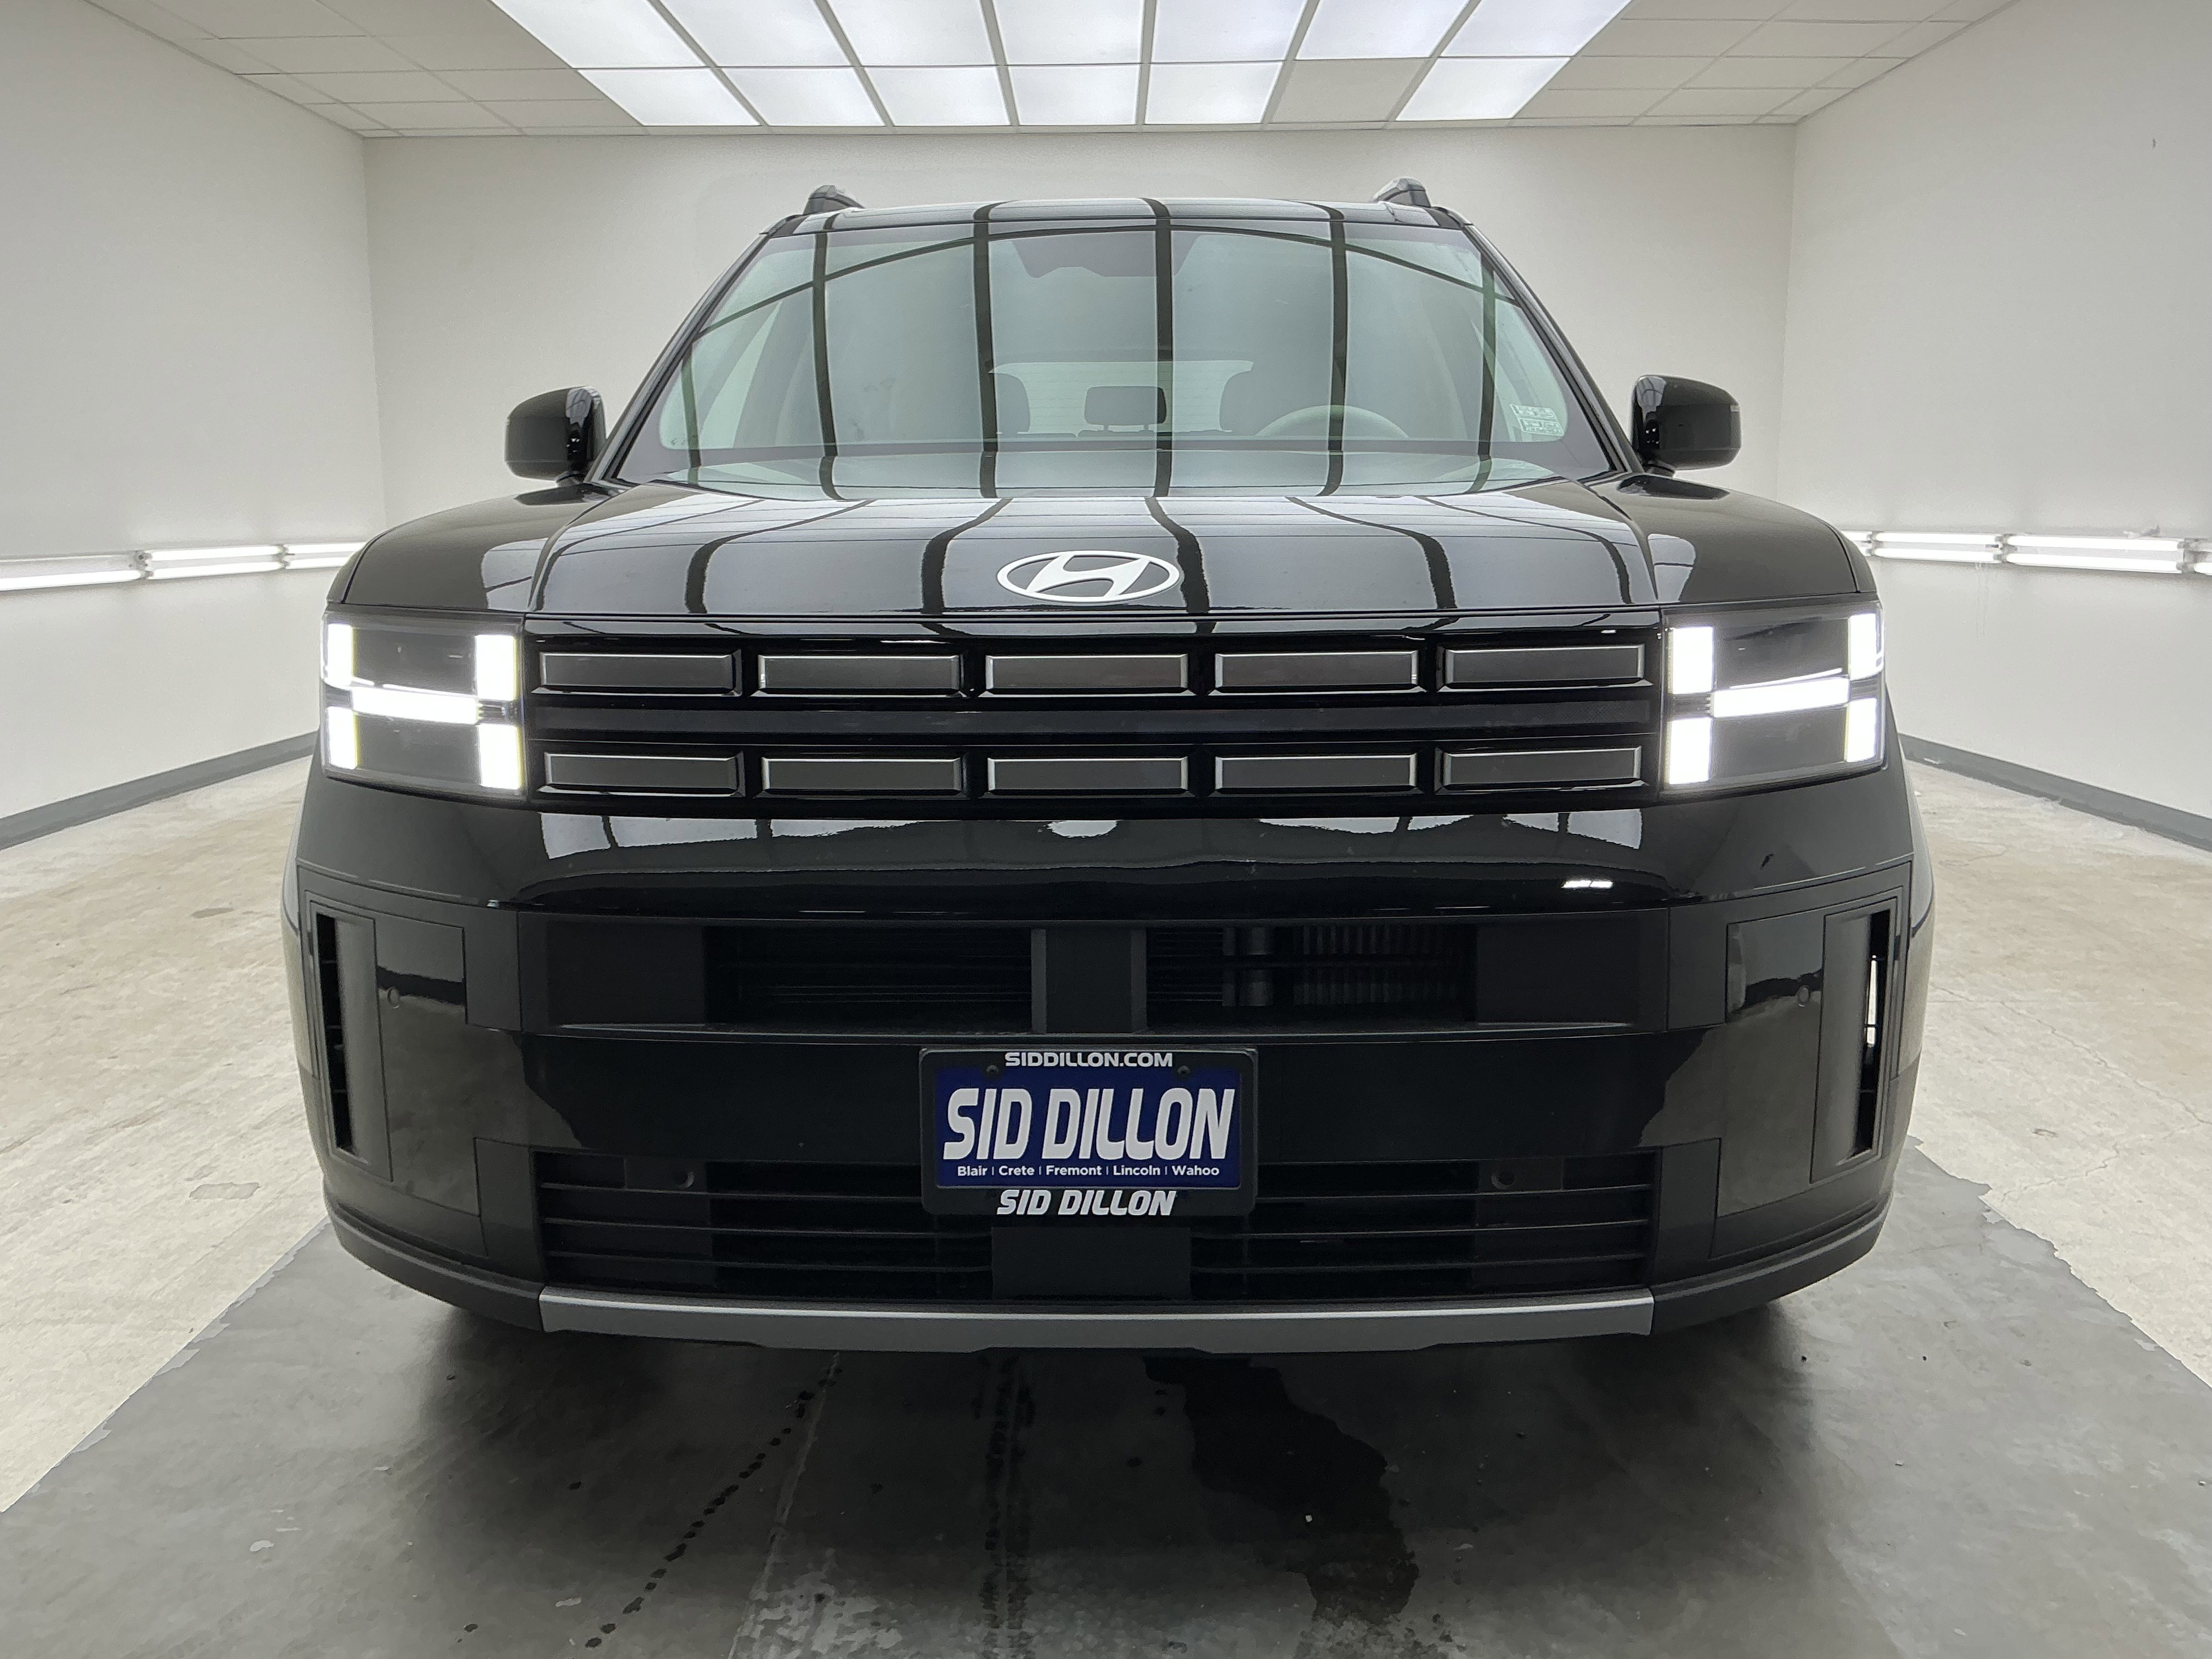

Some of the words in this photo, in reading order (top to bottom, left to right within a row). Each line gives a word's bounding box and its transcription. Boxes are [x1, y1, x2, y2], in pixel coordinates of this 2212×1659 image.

[1005, 1052, 1173, 1068] SIDDILLON.COM
[943, 1087, 1032, 1160] SID
[1041, 1087, 1235, 1160] DILLON
[957, 1165, 988, 1177] Blair
[998, 1165, 1035, 1176] Crete
[1046, 1165, 1102, 1176] Fremont
[1113, 1165, 1161, 1176] Lincoln
[1171, 1165, 1220, 1176] Wahoo
[996, 1189, 1052, 1215] SID
[1057, 1190, 1177, 1216] DILLON
